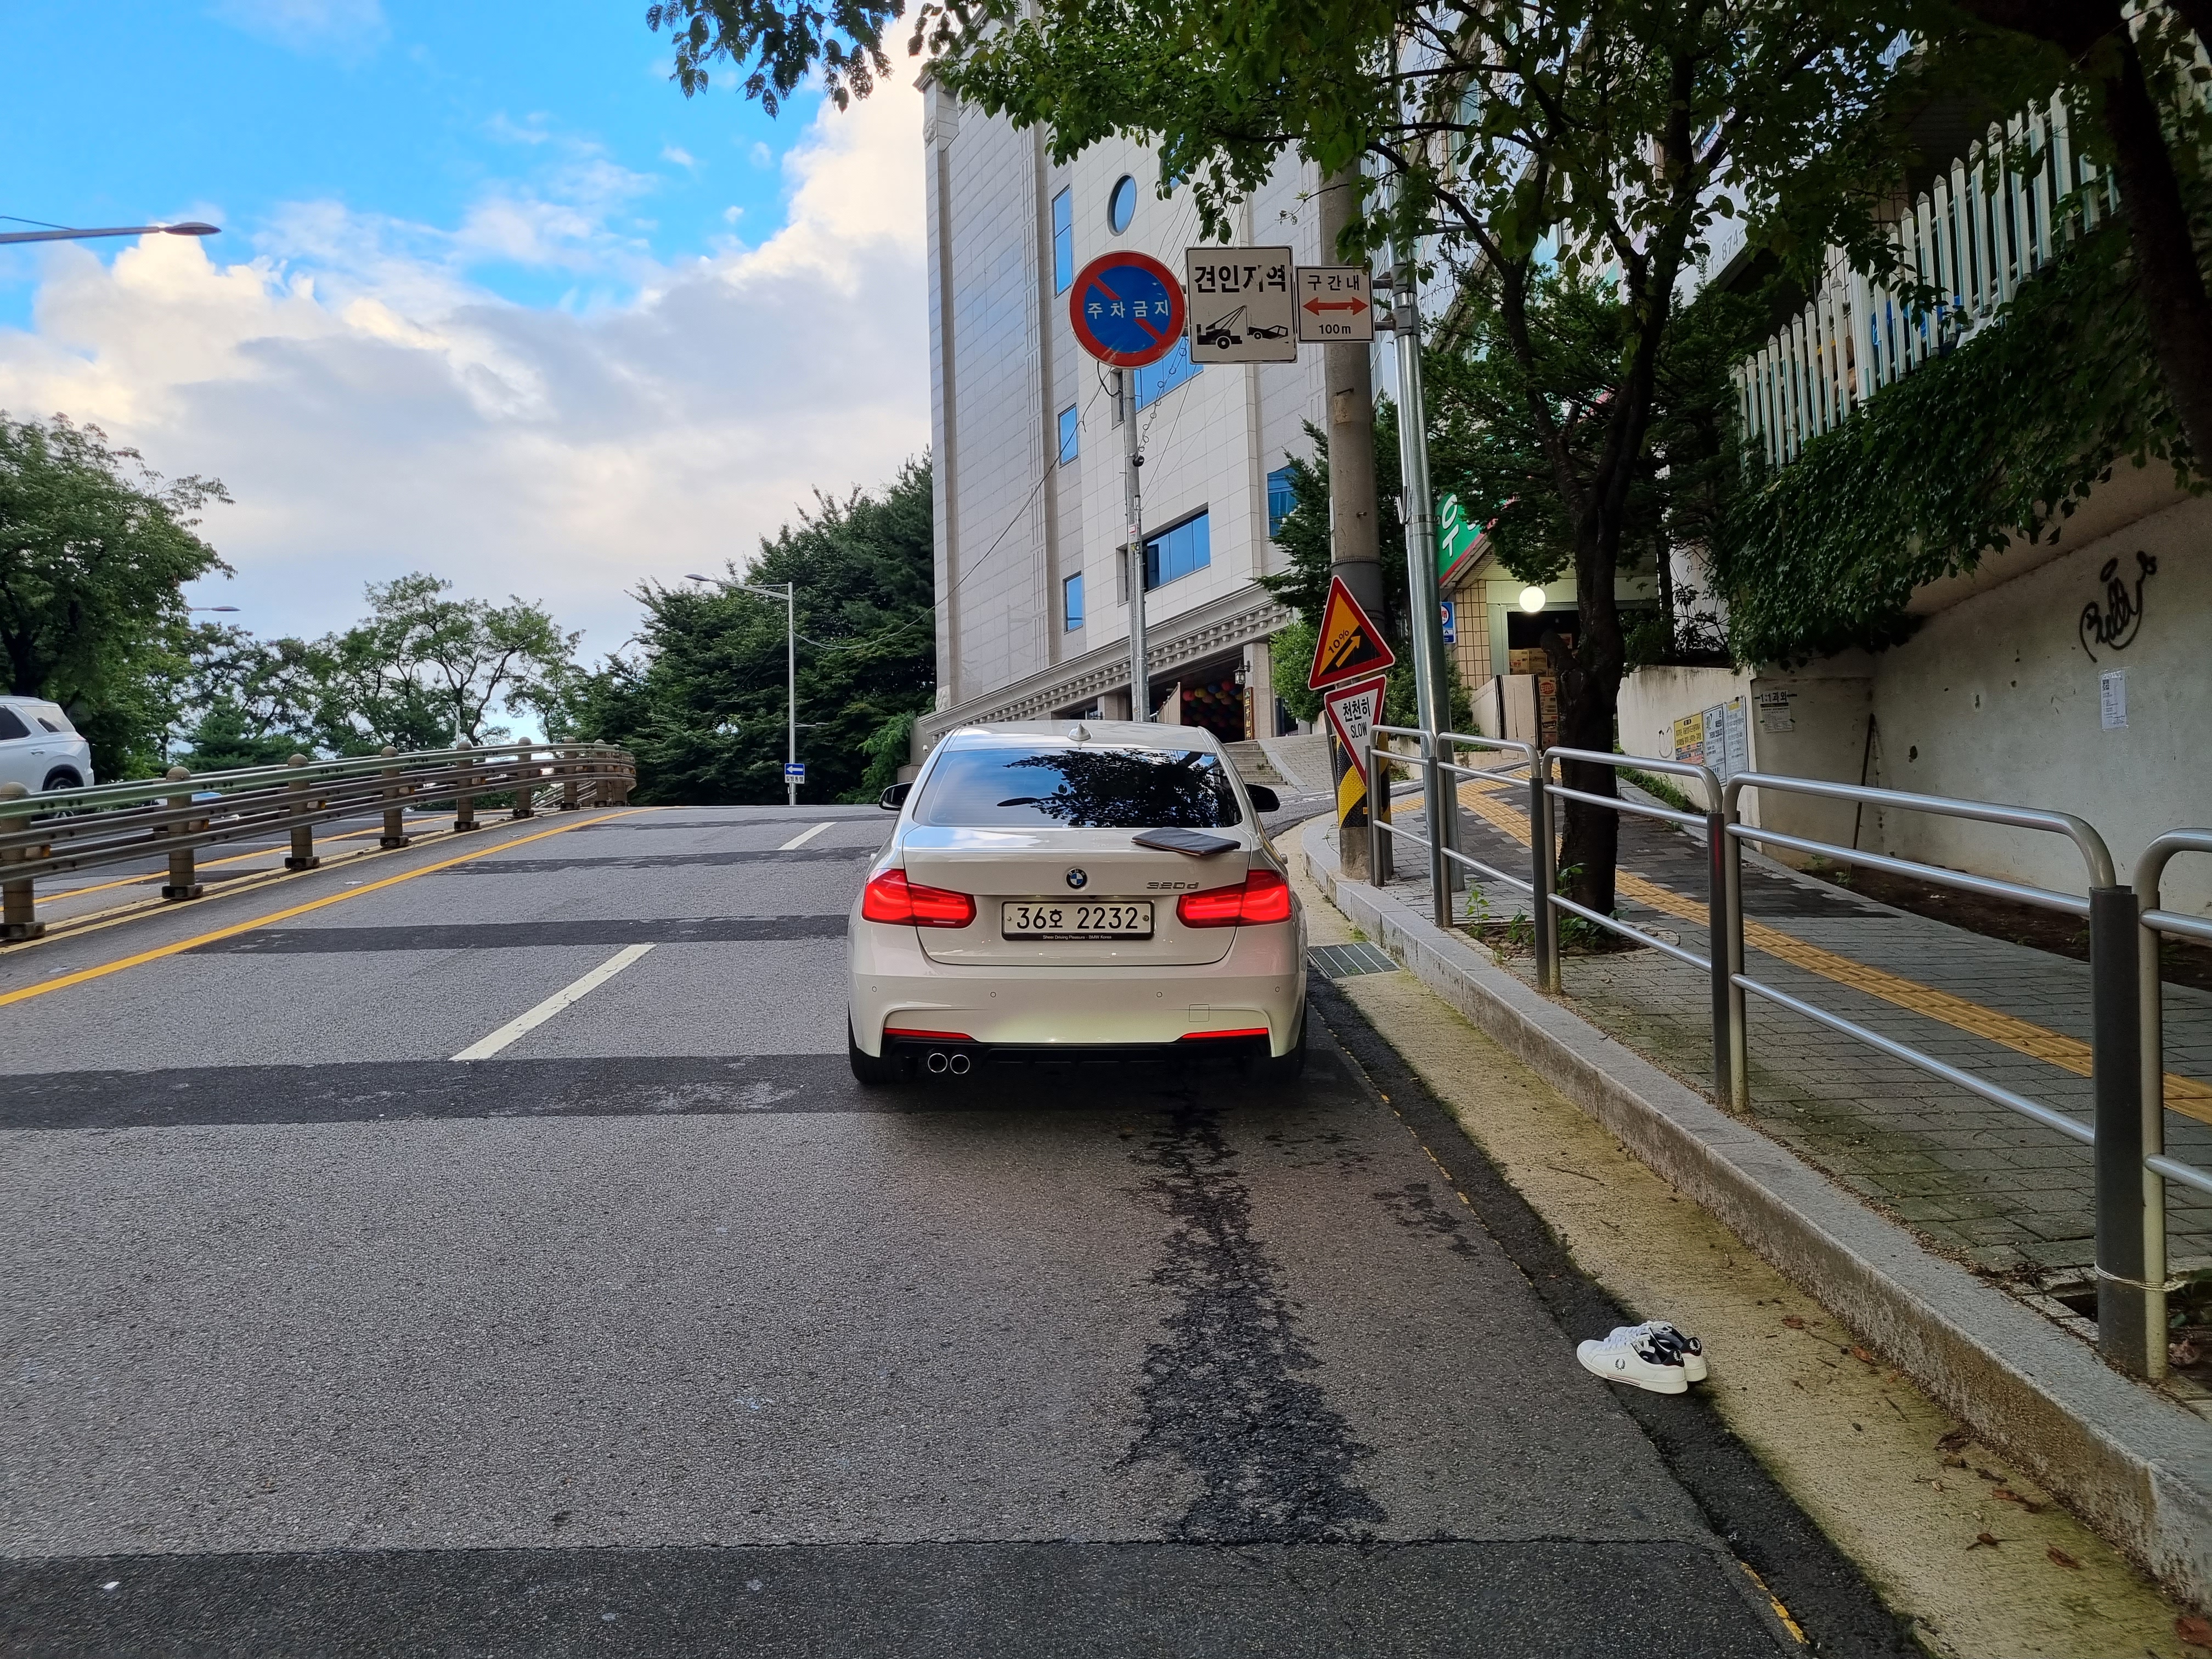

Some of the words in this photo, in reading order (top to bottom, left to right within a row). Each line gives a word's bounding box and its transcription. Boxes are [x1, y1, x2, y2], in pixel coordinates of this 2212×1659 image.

[1328, 629, 1350, 654] 10%
[1342, 696, 1371, 723] 천천히
[1350, 721, 1368, 739] SLOW
[1146, 881, 1200, 890] 320d
[1016, 907, 1063, 929] 36호
[1077, 907, 1138, 929] 2232
